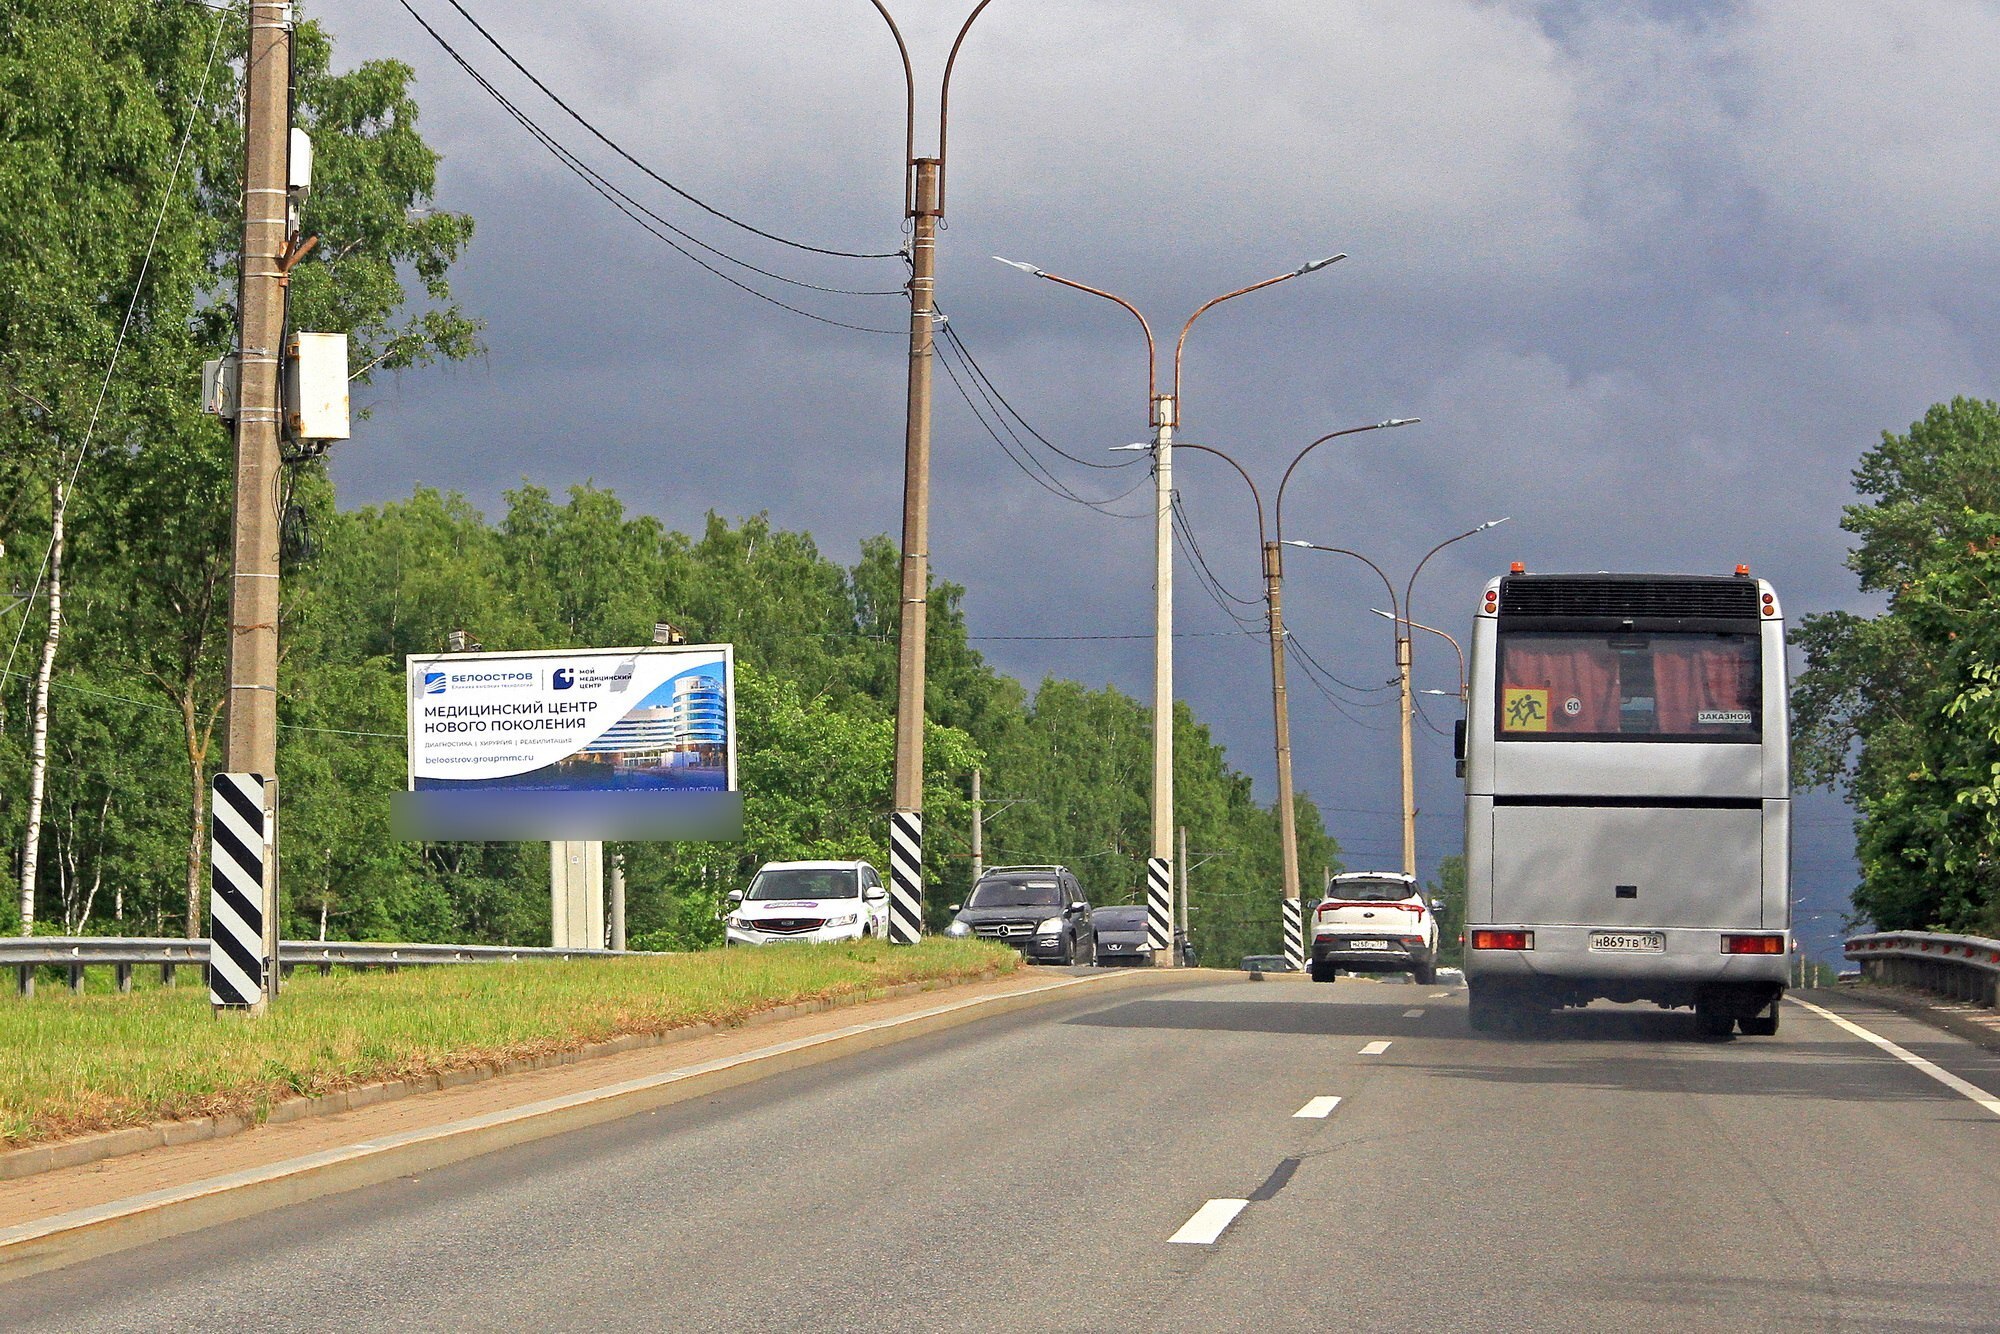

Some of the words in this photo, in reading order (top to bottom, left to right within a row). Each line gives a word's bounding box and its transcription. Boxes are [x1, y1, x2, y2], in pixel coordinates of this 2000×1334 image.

[451, 672, 533, 682] БЕЛООСТРОВ
[579, 673, 632, 682] МЕДИЦИНСКИЙ
[424, 700, 544, 718] МЕДИЦИНСКИЙ
[548, 701, 598, 715] ЦЕНТР
[1566, 701, 1579, 711] 60
[424, 721, 487, 733] НОВОГО
[491, 718, 586, 731] ПОКОЛЕНИЯ
[425, 754, 534, 764] beloostrov.groupmmc.ru
[1595, 936, 1639, 948] Н869ТВ
[1641, 936, 1658, 946] 178
